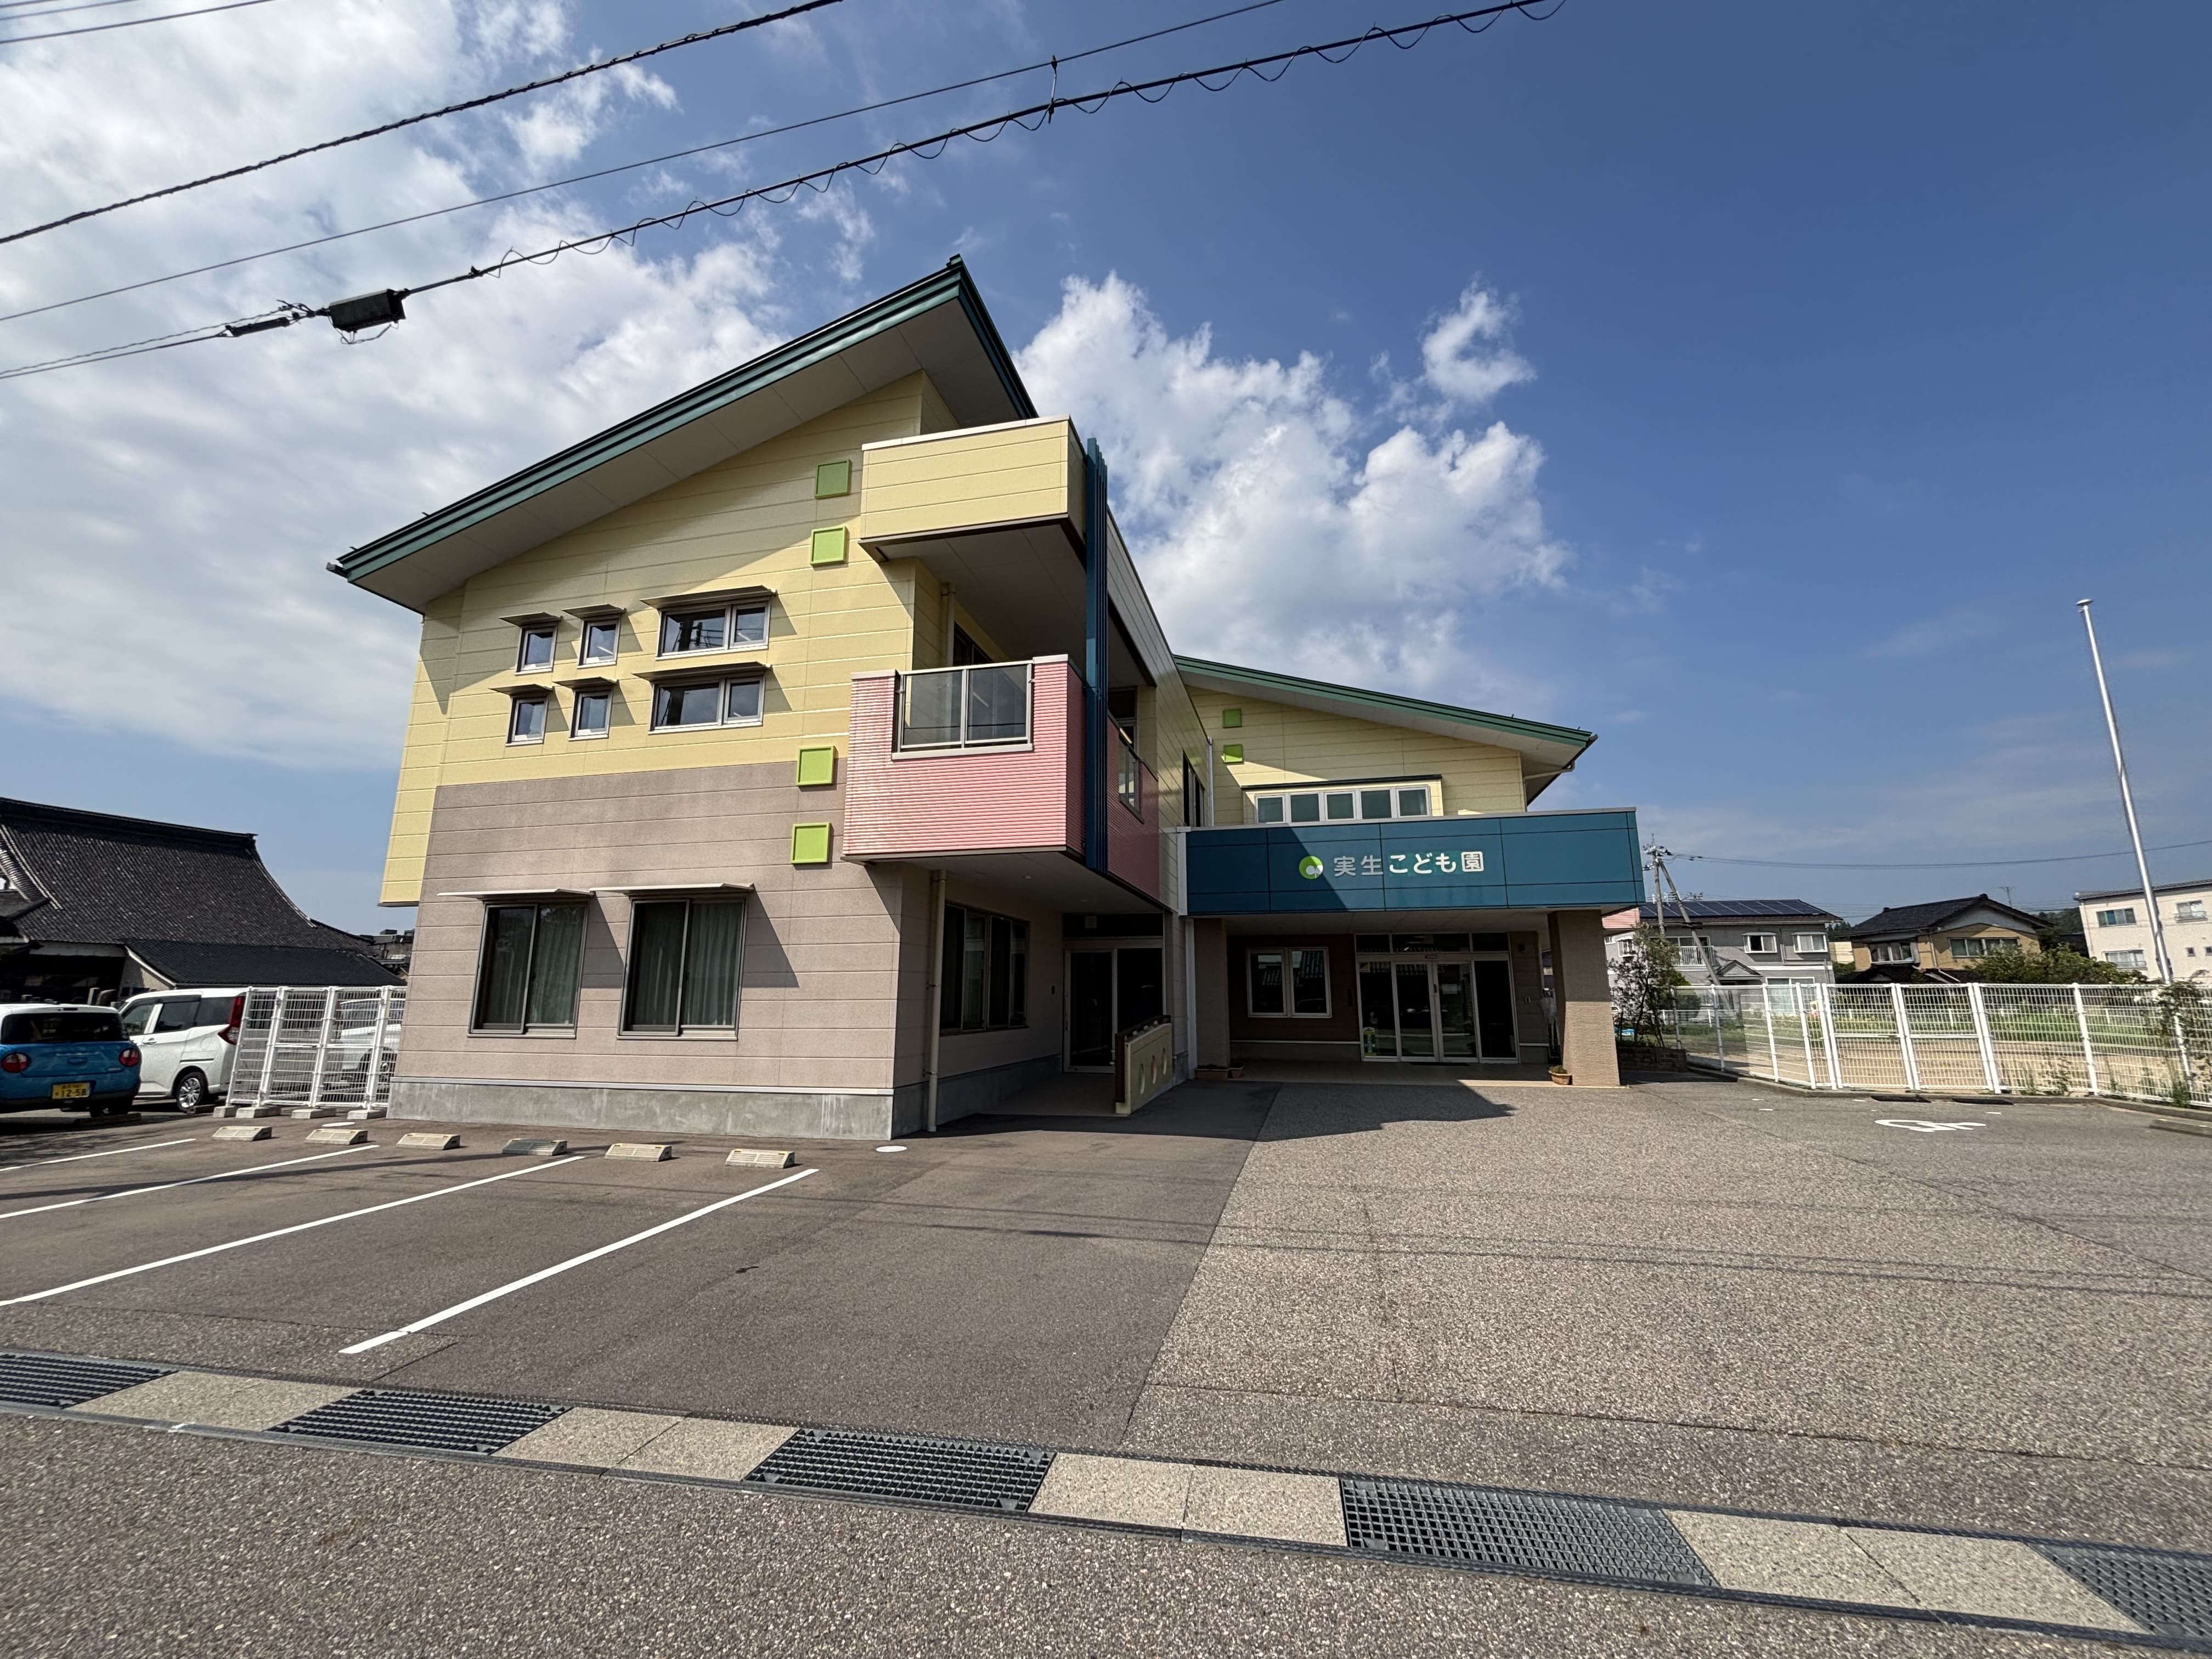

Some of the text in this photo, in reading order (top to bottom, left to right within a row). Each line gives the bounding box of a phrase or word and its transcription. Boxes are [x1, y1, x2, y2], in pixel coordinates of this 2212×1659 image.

[1333, 851, 1484, 878] 実生こども園
